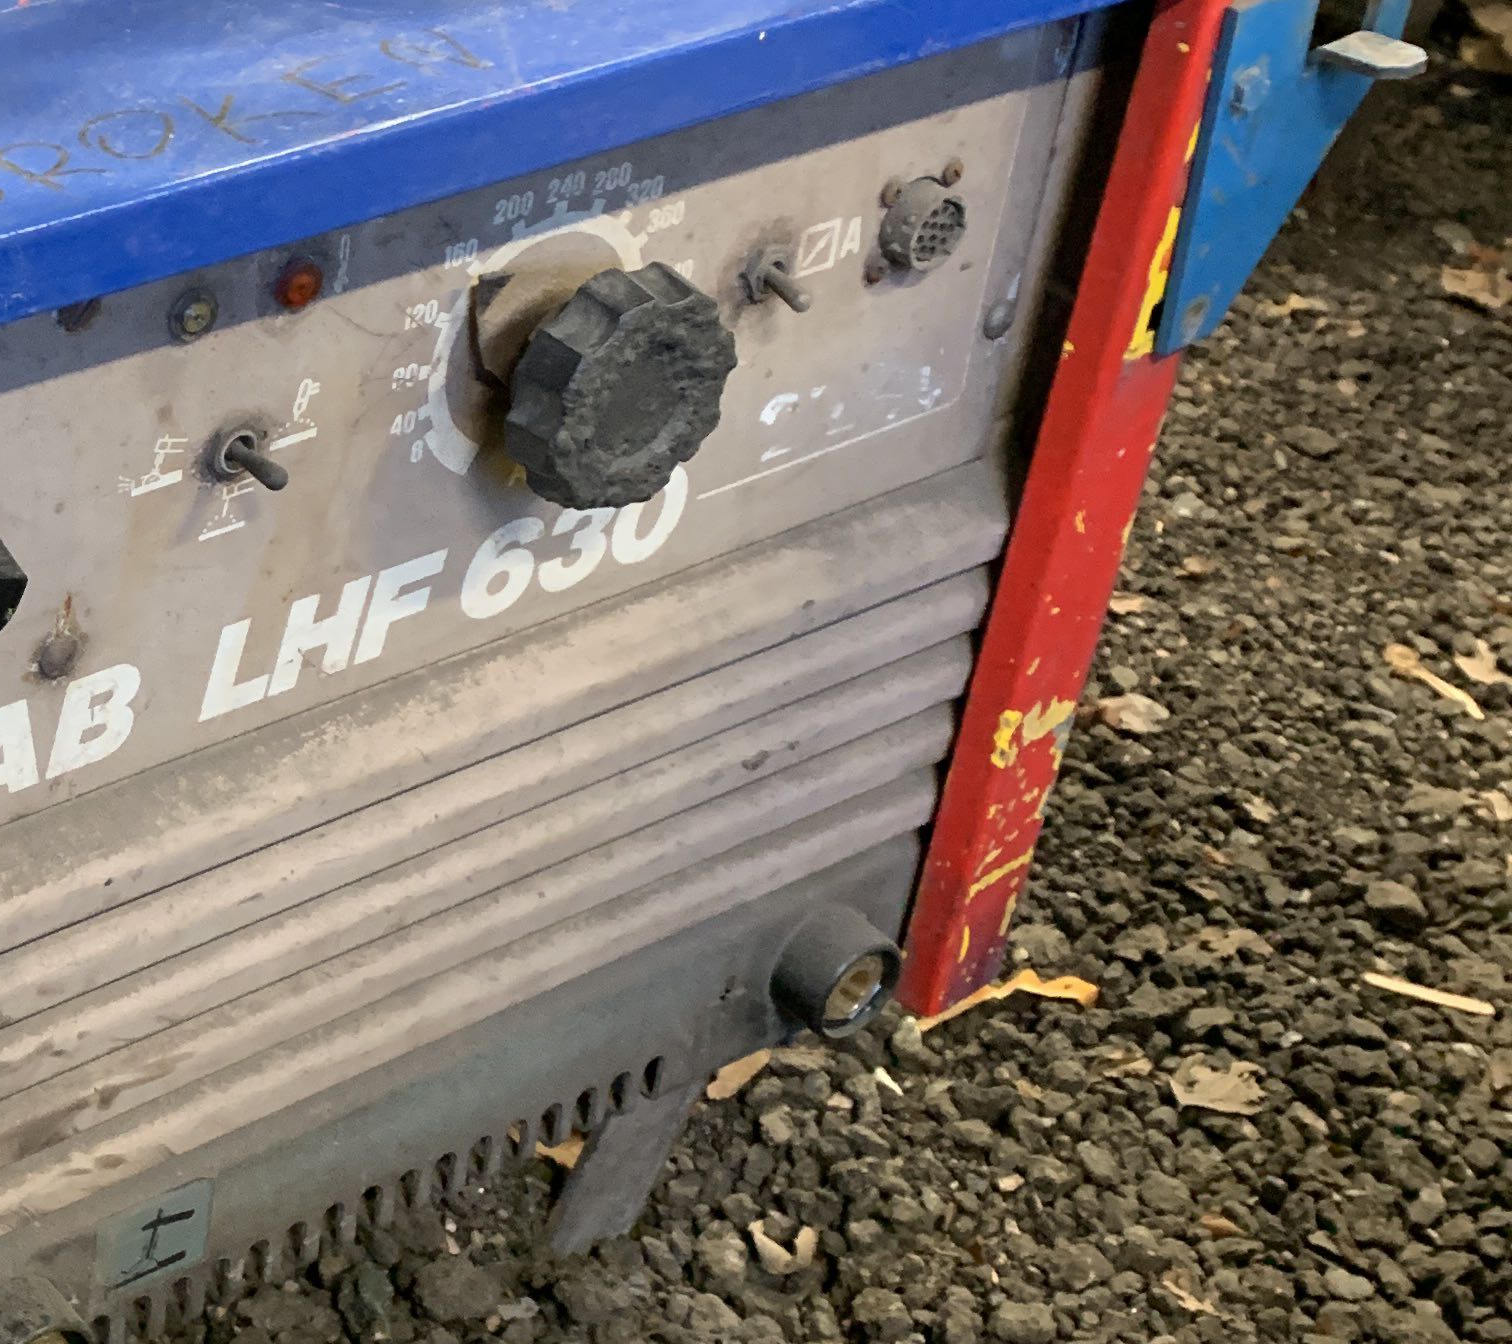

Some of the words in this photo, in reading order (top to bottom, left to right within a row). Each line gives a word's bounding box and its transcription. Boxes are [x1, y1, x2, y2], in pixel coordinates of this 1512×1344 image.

[390, 410, 416, 435] 40
[404, 299, 438, 330] 120
[493, 190, 534, 226] 200
[547, 171, 586, 203] 240
[625, 175, 665, 206] 320
[198, 548, 449, 724] LHF
[459, 462, 689, 620] 630
